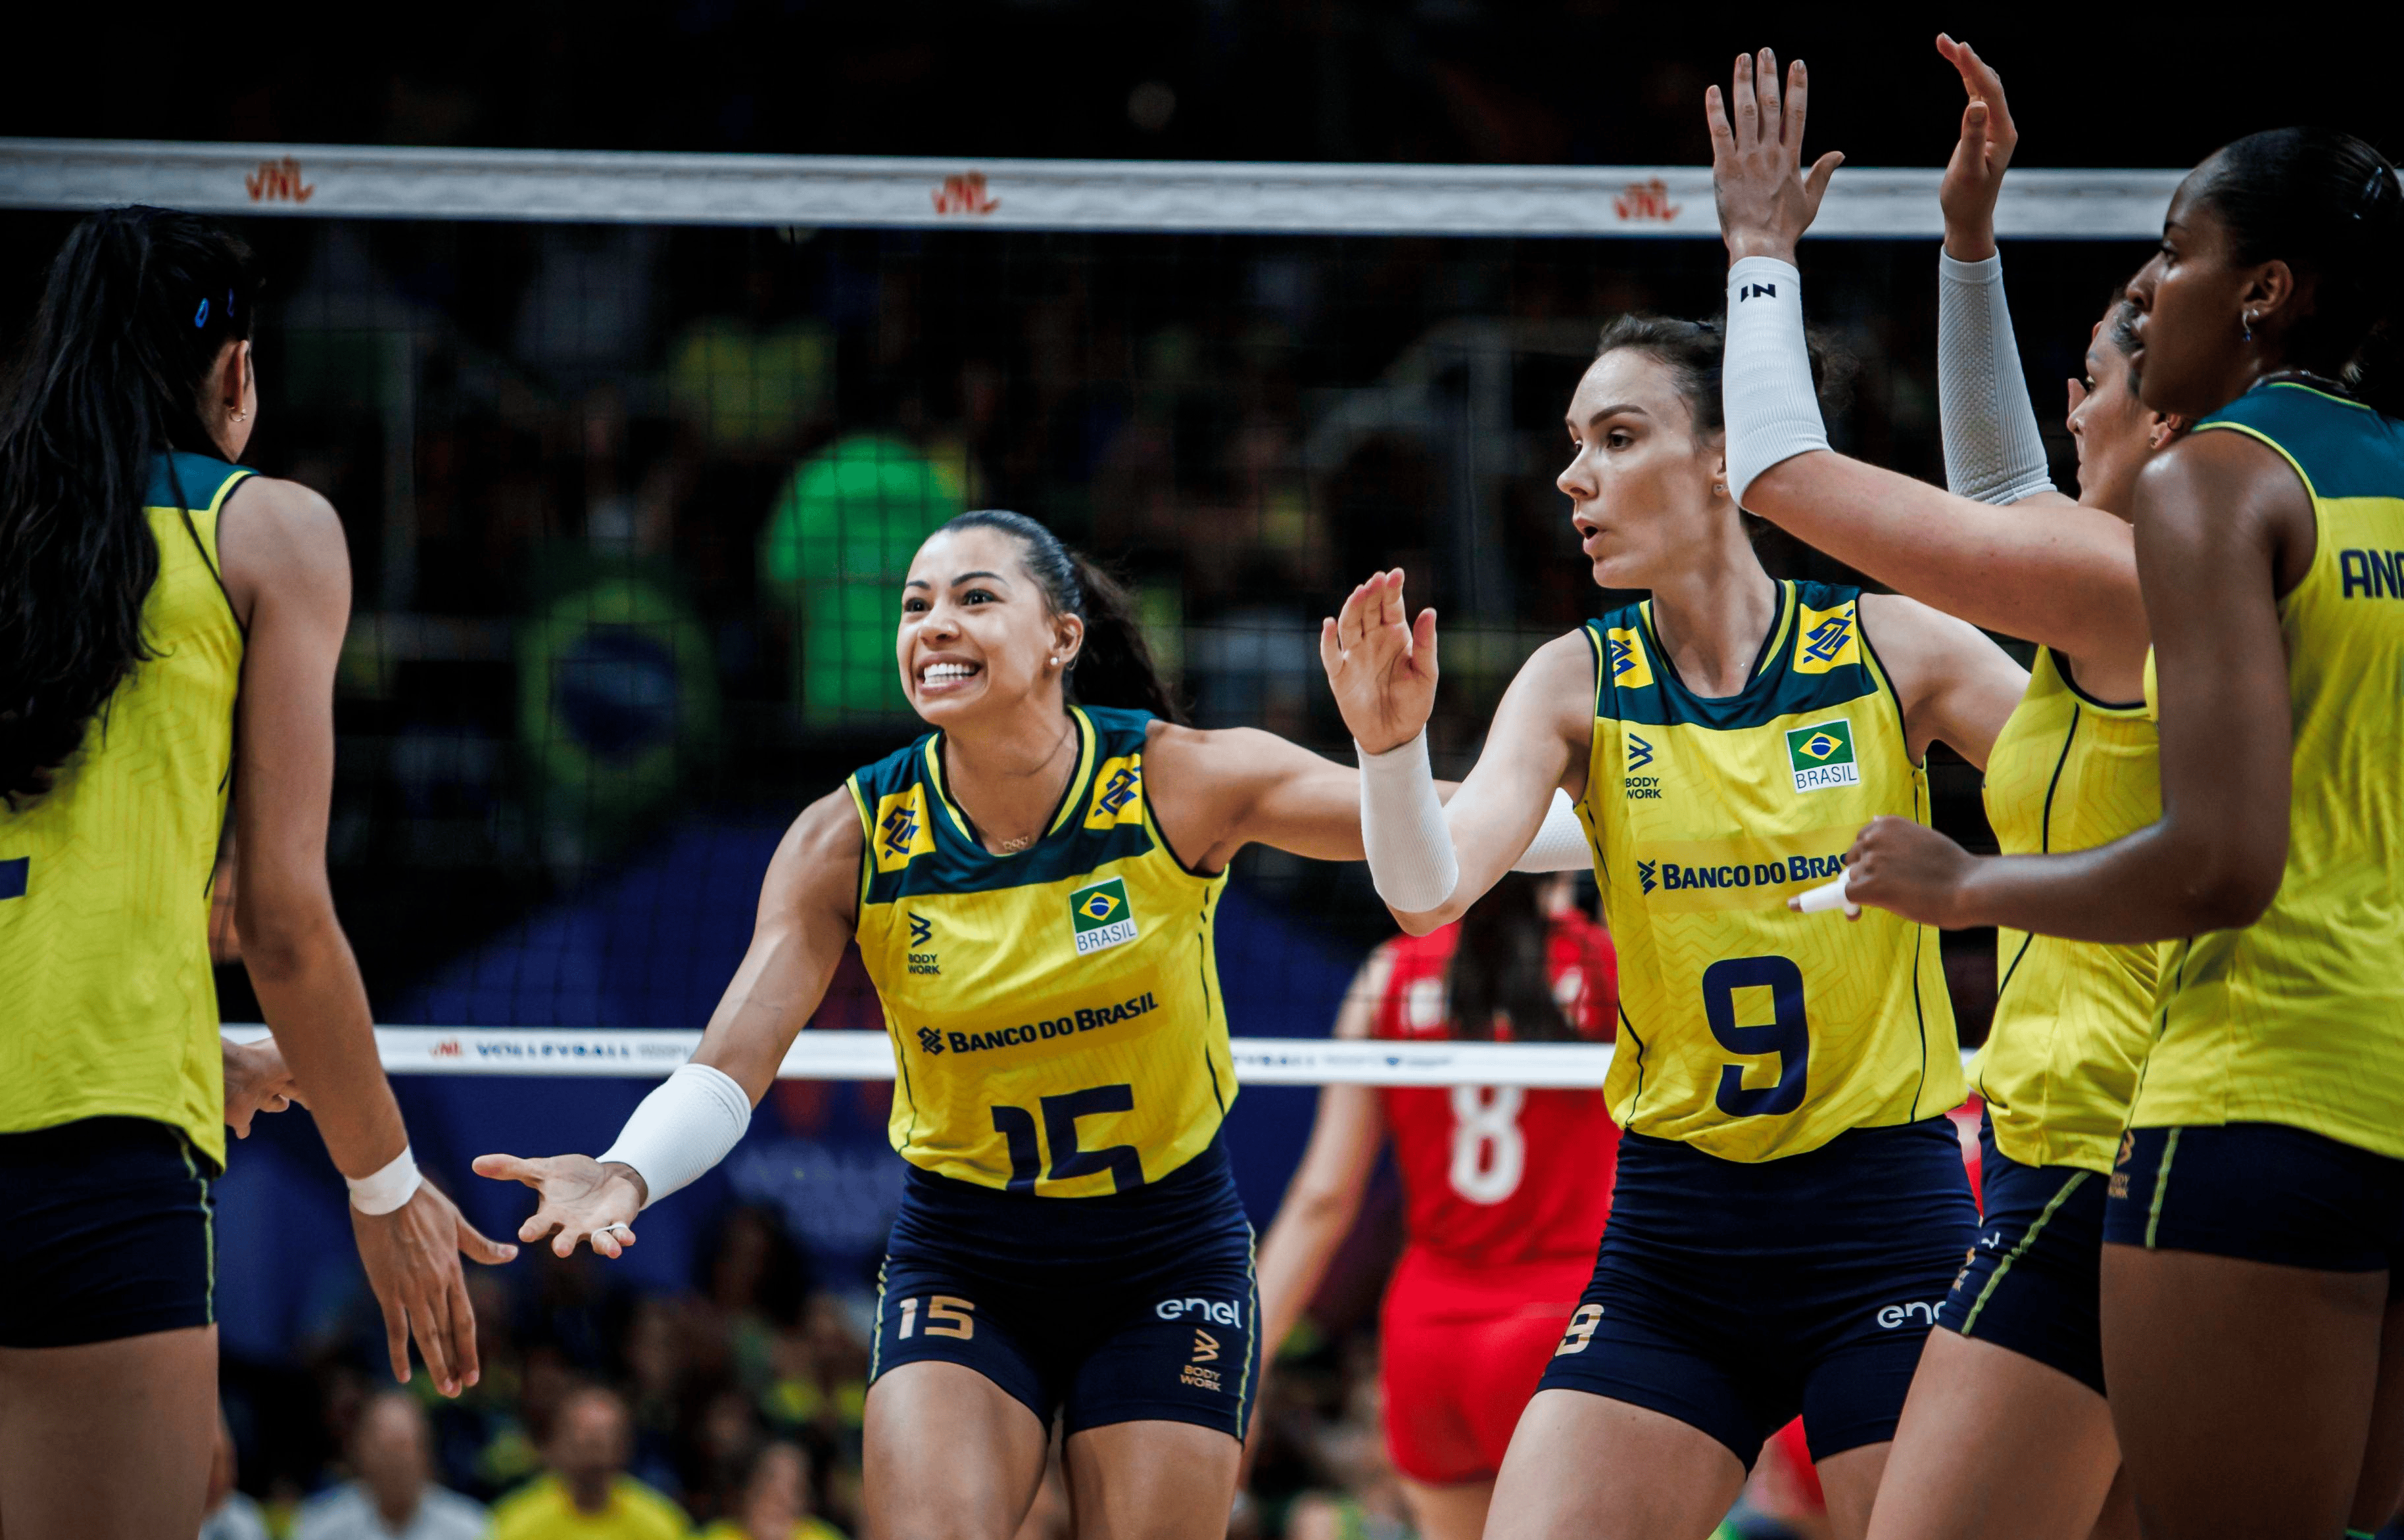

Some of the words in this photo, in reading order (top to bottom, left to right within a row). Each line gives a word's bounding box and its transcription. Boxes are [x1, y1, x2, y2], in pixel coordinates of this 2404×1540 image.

[1625, 777, 1660, 788] BODY
[1796, 766, 1858, 789] BRASIL
[1662, 863, 1750, 890] BANCO
[1754, 862, 1787, 886] DO
[1077, 923, 1136, 951] BRASIL
[908, 953, 938, 964] BODY
[908, 965, 941, 975] WORK
[948, 1024, 1036, 1053] BANCO
[1038, 1017, 1074, 1039] DO
[1074, 991, 1159, 1032] BRASIL
[1702, 955, 1810, 1117] 9
[991, 1084, 1145, 1195] 15
[1451, 1084, 1526, 1205] 8
[899, 1295, 975, 1339] 15
[1156, 1298, 1241, 1329] enel
[1555, 1304, 1604, 1357] 9
[1180, 1374, 1221, 1391] WORK
[1184, 1364, 1221, 1380] BODY
